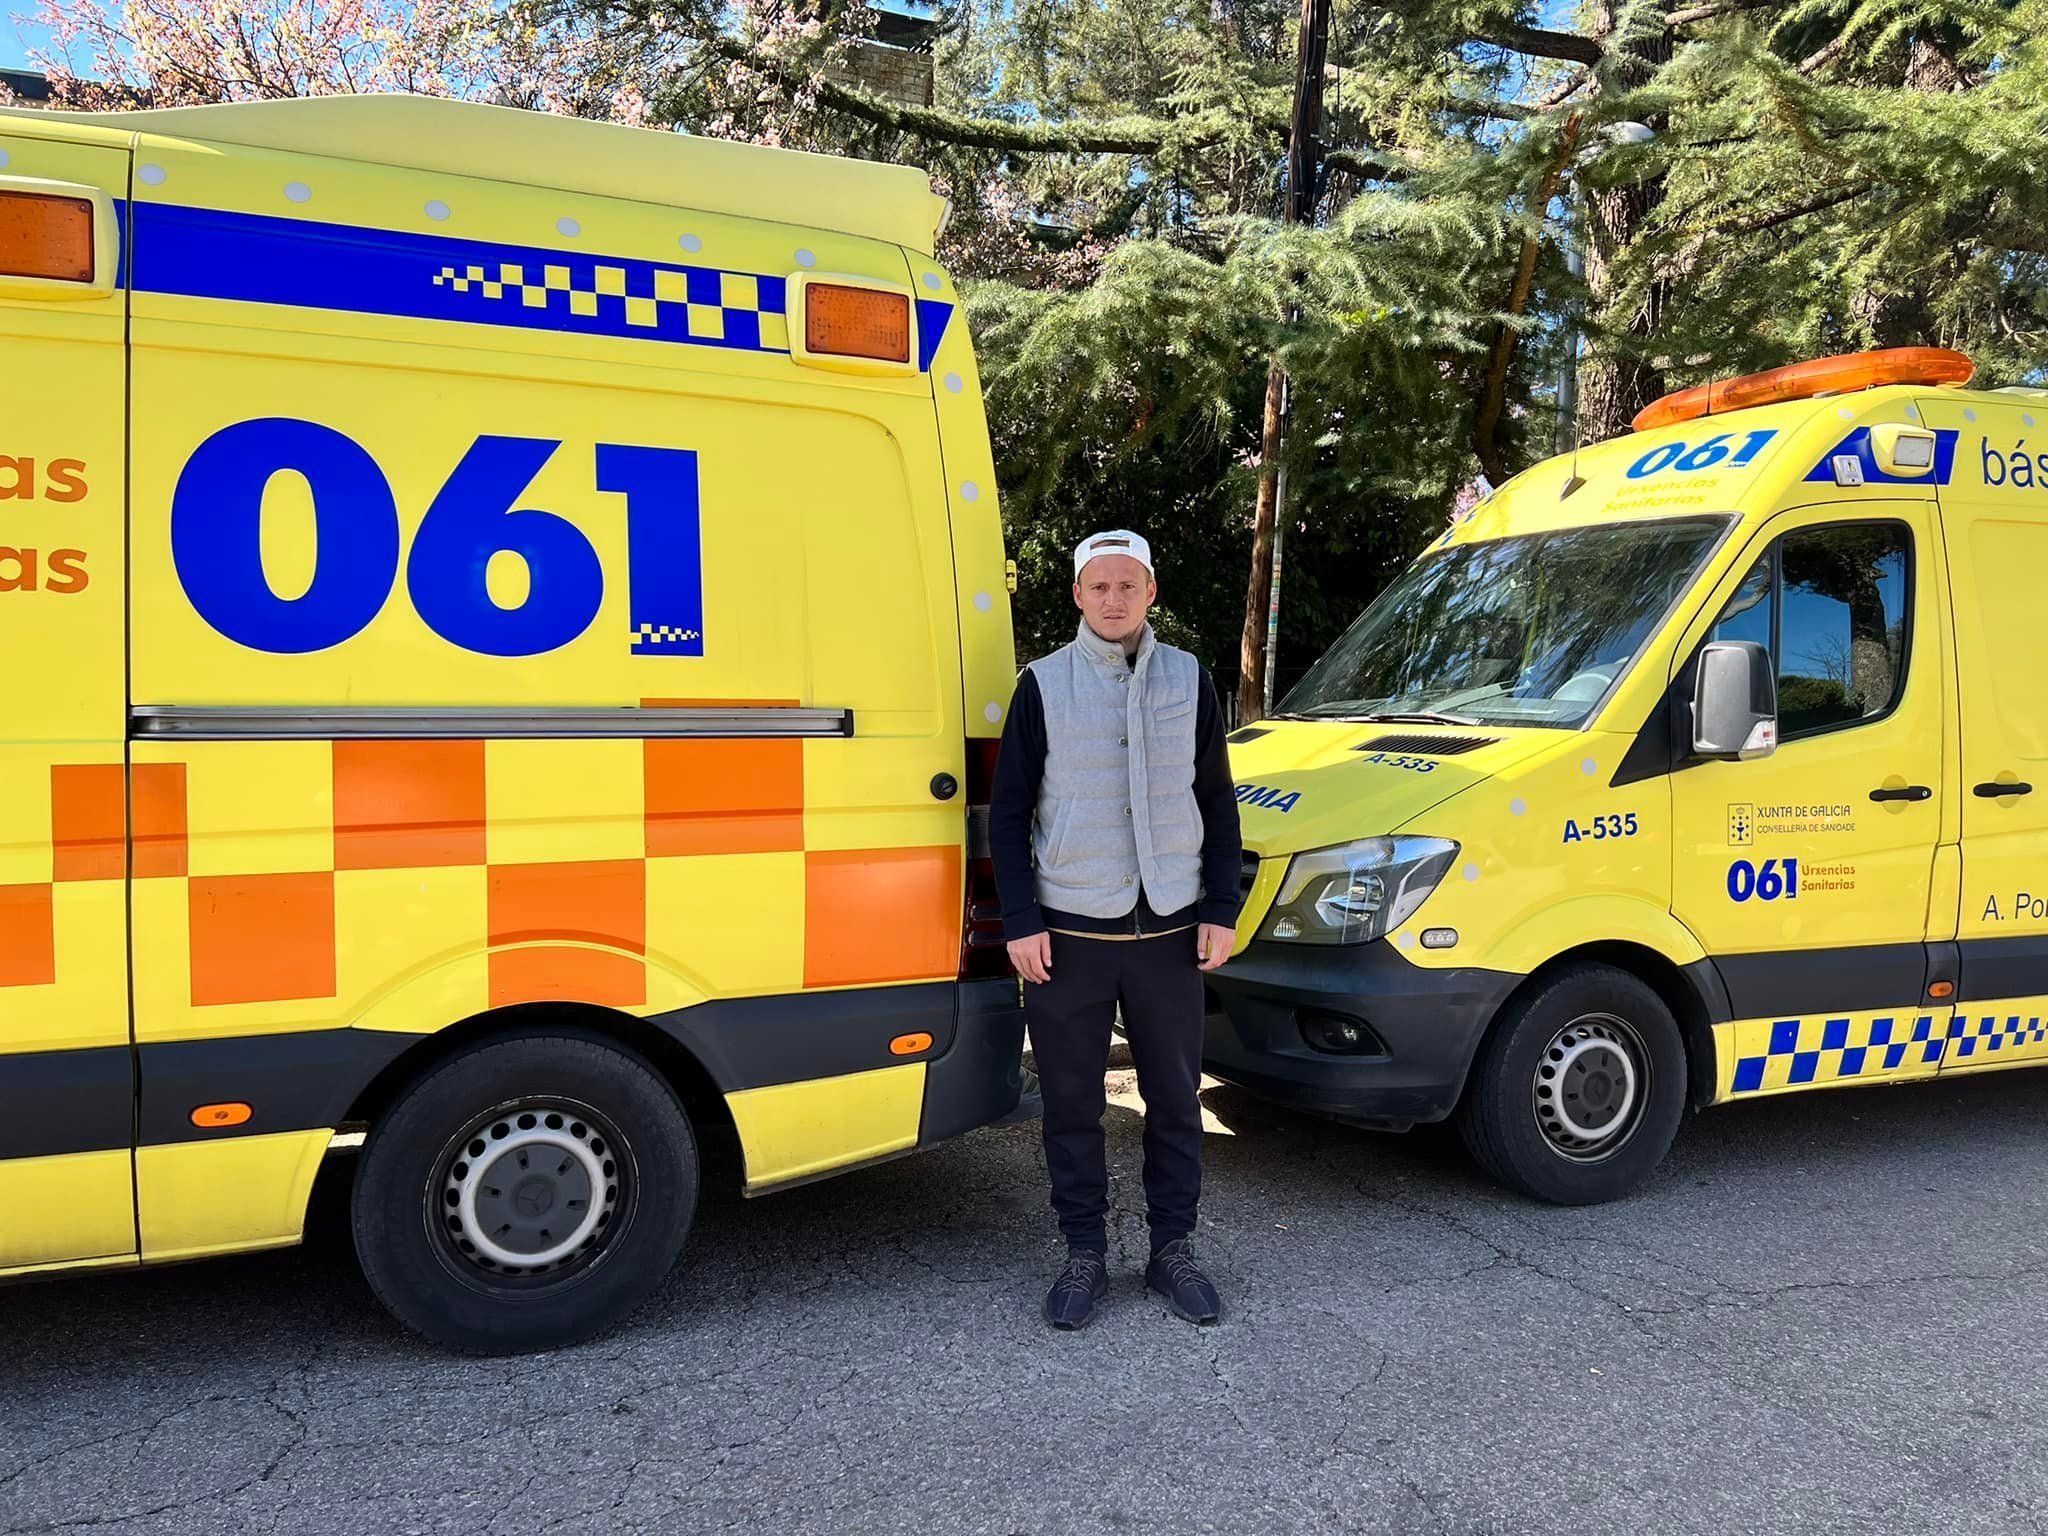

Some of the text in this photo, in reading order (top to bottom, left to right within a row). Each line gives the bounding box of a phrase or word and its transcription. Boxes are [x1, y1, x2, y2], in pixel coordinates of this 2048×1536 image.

[1626, 430, 1779, 478] 061
[0, 455, 88, 503] as
[171, 417, 704, 657] 061
[0, 546, 89, 593] as
[1363, 753, 1439, 773] A-535
[1757, 805, 1851, 818] XUNTA DE GALICIA
[1562, 813, 1638, 843] A-535
[1809, 824, 1819, 832] DE
[1727, 858, 1797, 902] 061
[1801, 864, 1856, 876] Urxencias
[1801, 879, 1855, 891] Sanitarias
[1981, 895, 2005, 921] A.
